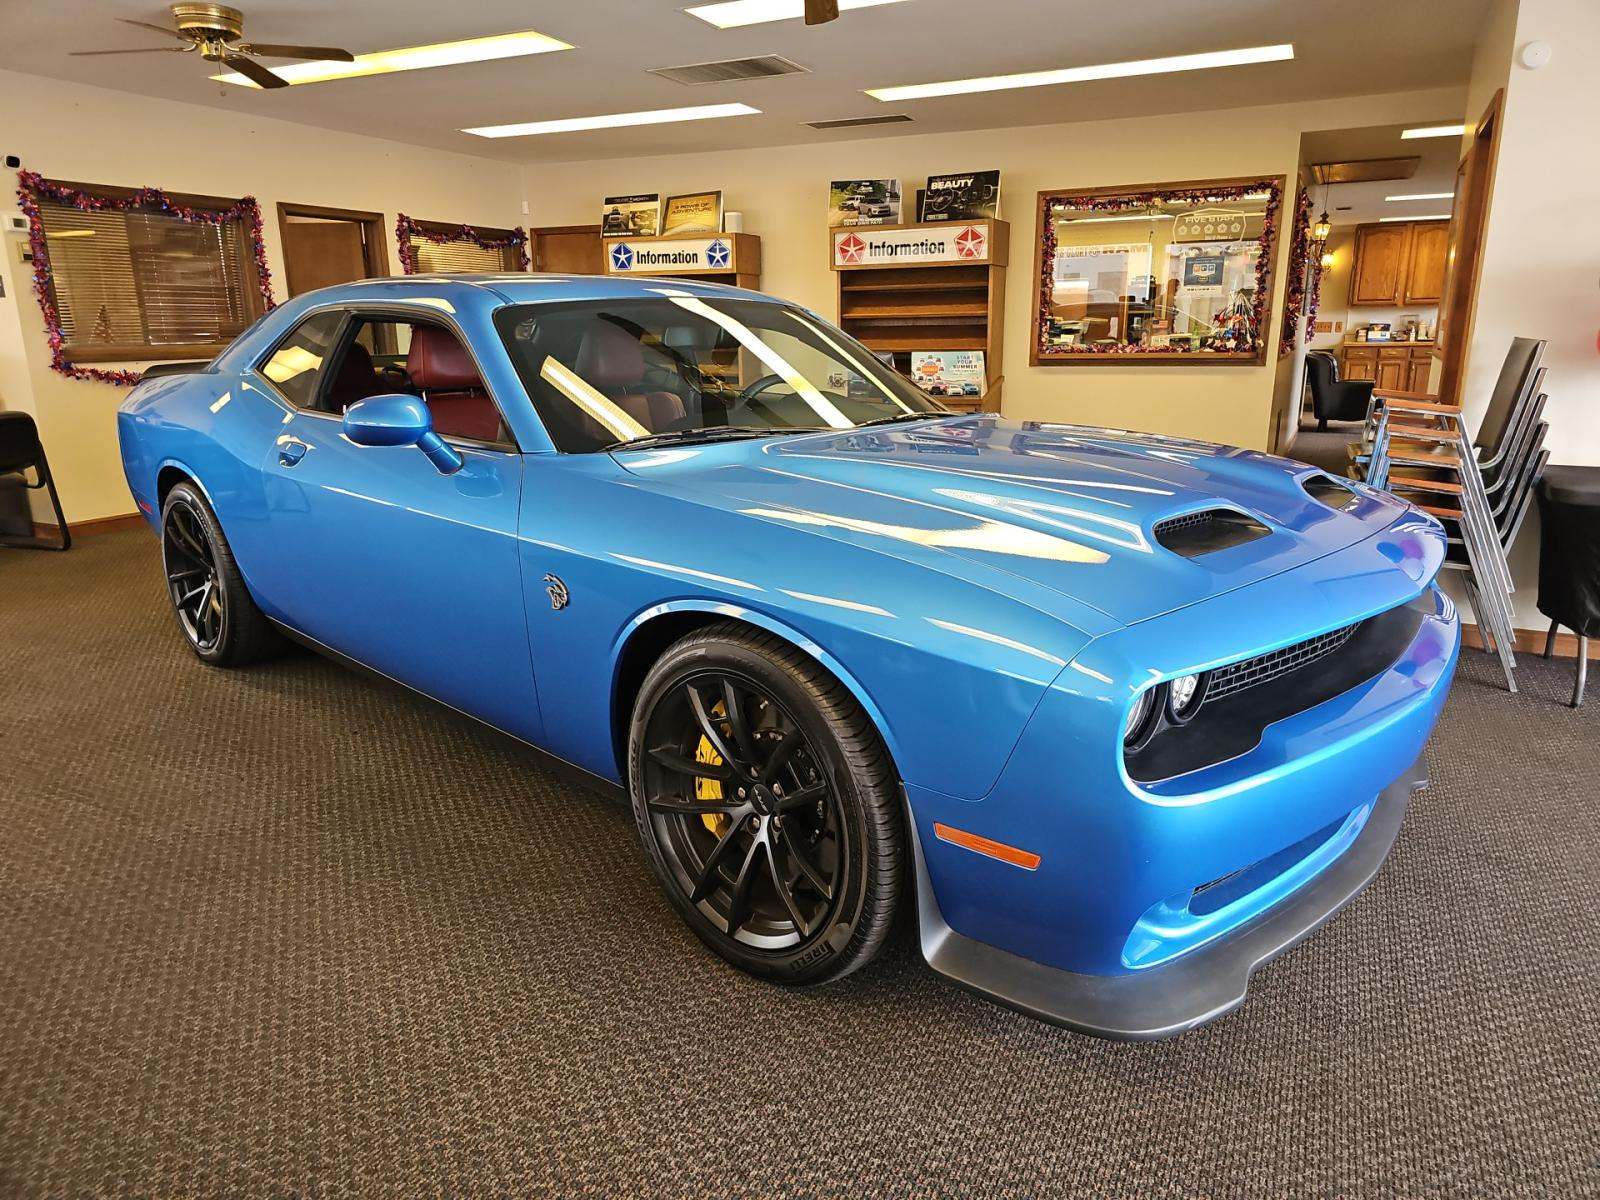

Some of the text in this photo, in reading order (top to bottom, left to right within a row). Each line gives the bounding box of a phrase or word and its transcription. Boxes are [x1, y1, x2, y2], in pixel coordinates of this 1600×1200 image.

[931, 178, 974, 190] BEAUTY
[869, 238, 945, 257] Information
[636, 250, 698, 264] Information
